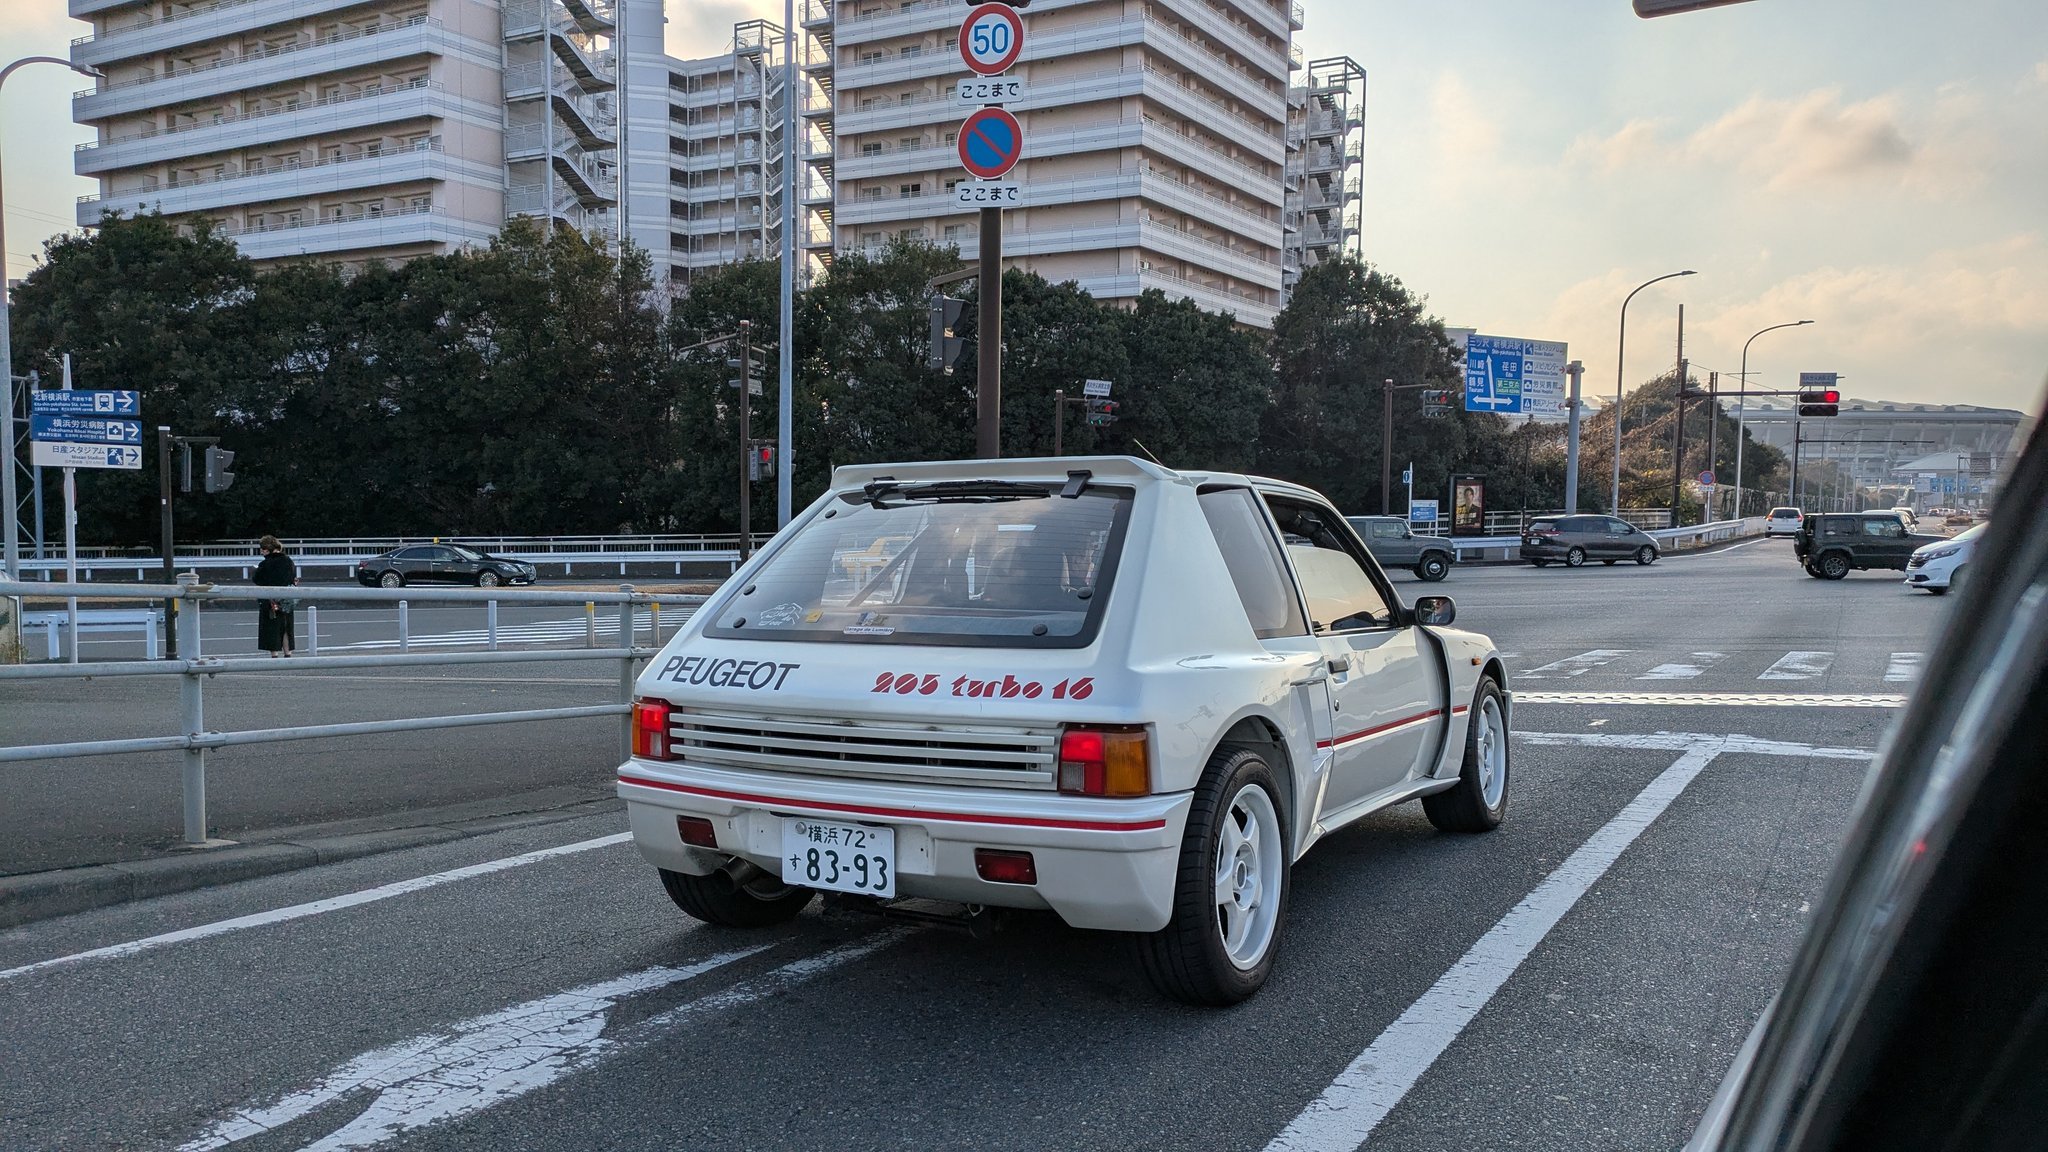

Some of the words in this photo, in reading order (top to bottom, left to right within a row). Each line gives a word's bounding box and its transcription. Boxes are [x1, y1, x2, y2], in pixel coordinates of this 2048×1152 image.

[973, 22, 1009, 55] 50
[961, 82, 1020, 99] ここまで
[959, 186, 1019, 202] ここまで
[1470, 360, 1484, 370] 川崎
[1502, 362, 1517, 372] 荏田
[53, 418, 106, 430] 横浜労災病院
[52, 446, 106, 455] 日産スタジアム
[656, 655, 801, 691] PEUGEOT
[870, 671, 941, 695] 205
[951, 673, 1043, 699] turbo
[1052, 677, 1095, 700] 16
[808, 825, 838, 845] 横浜
[842, 828, 866, 849] 72
[789, 853, 802, 872] す
[806, 847, 888, 891] 83-93
